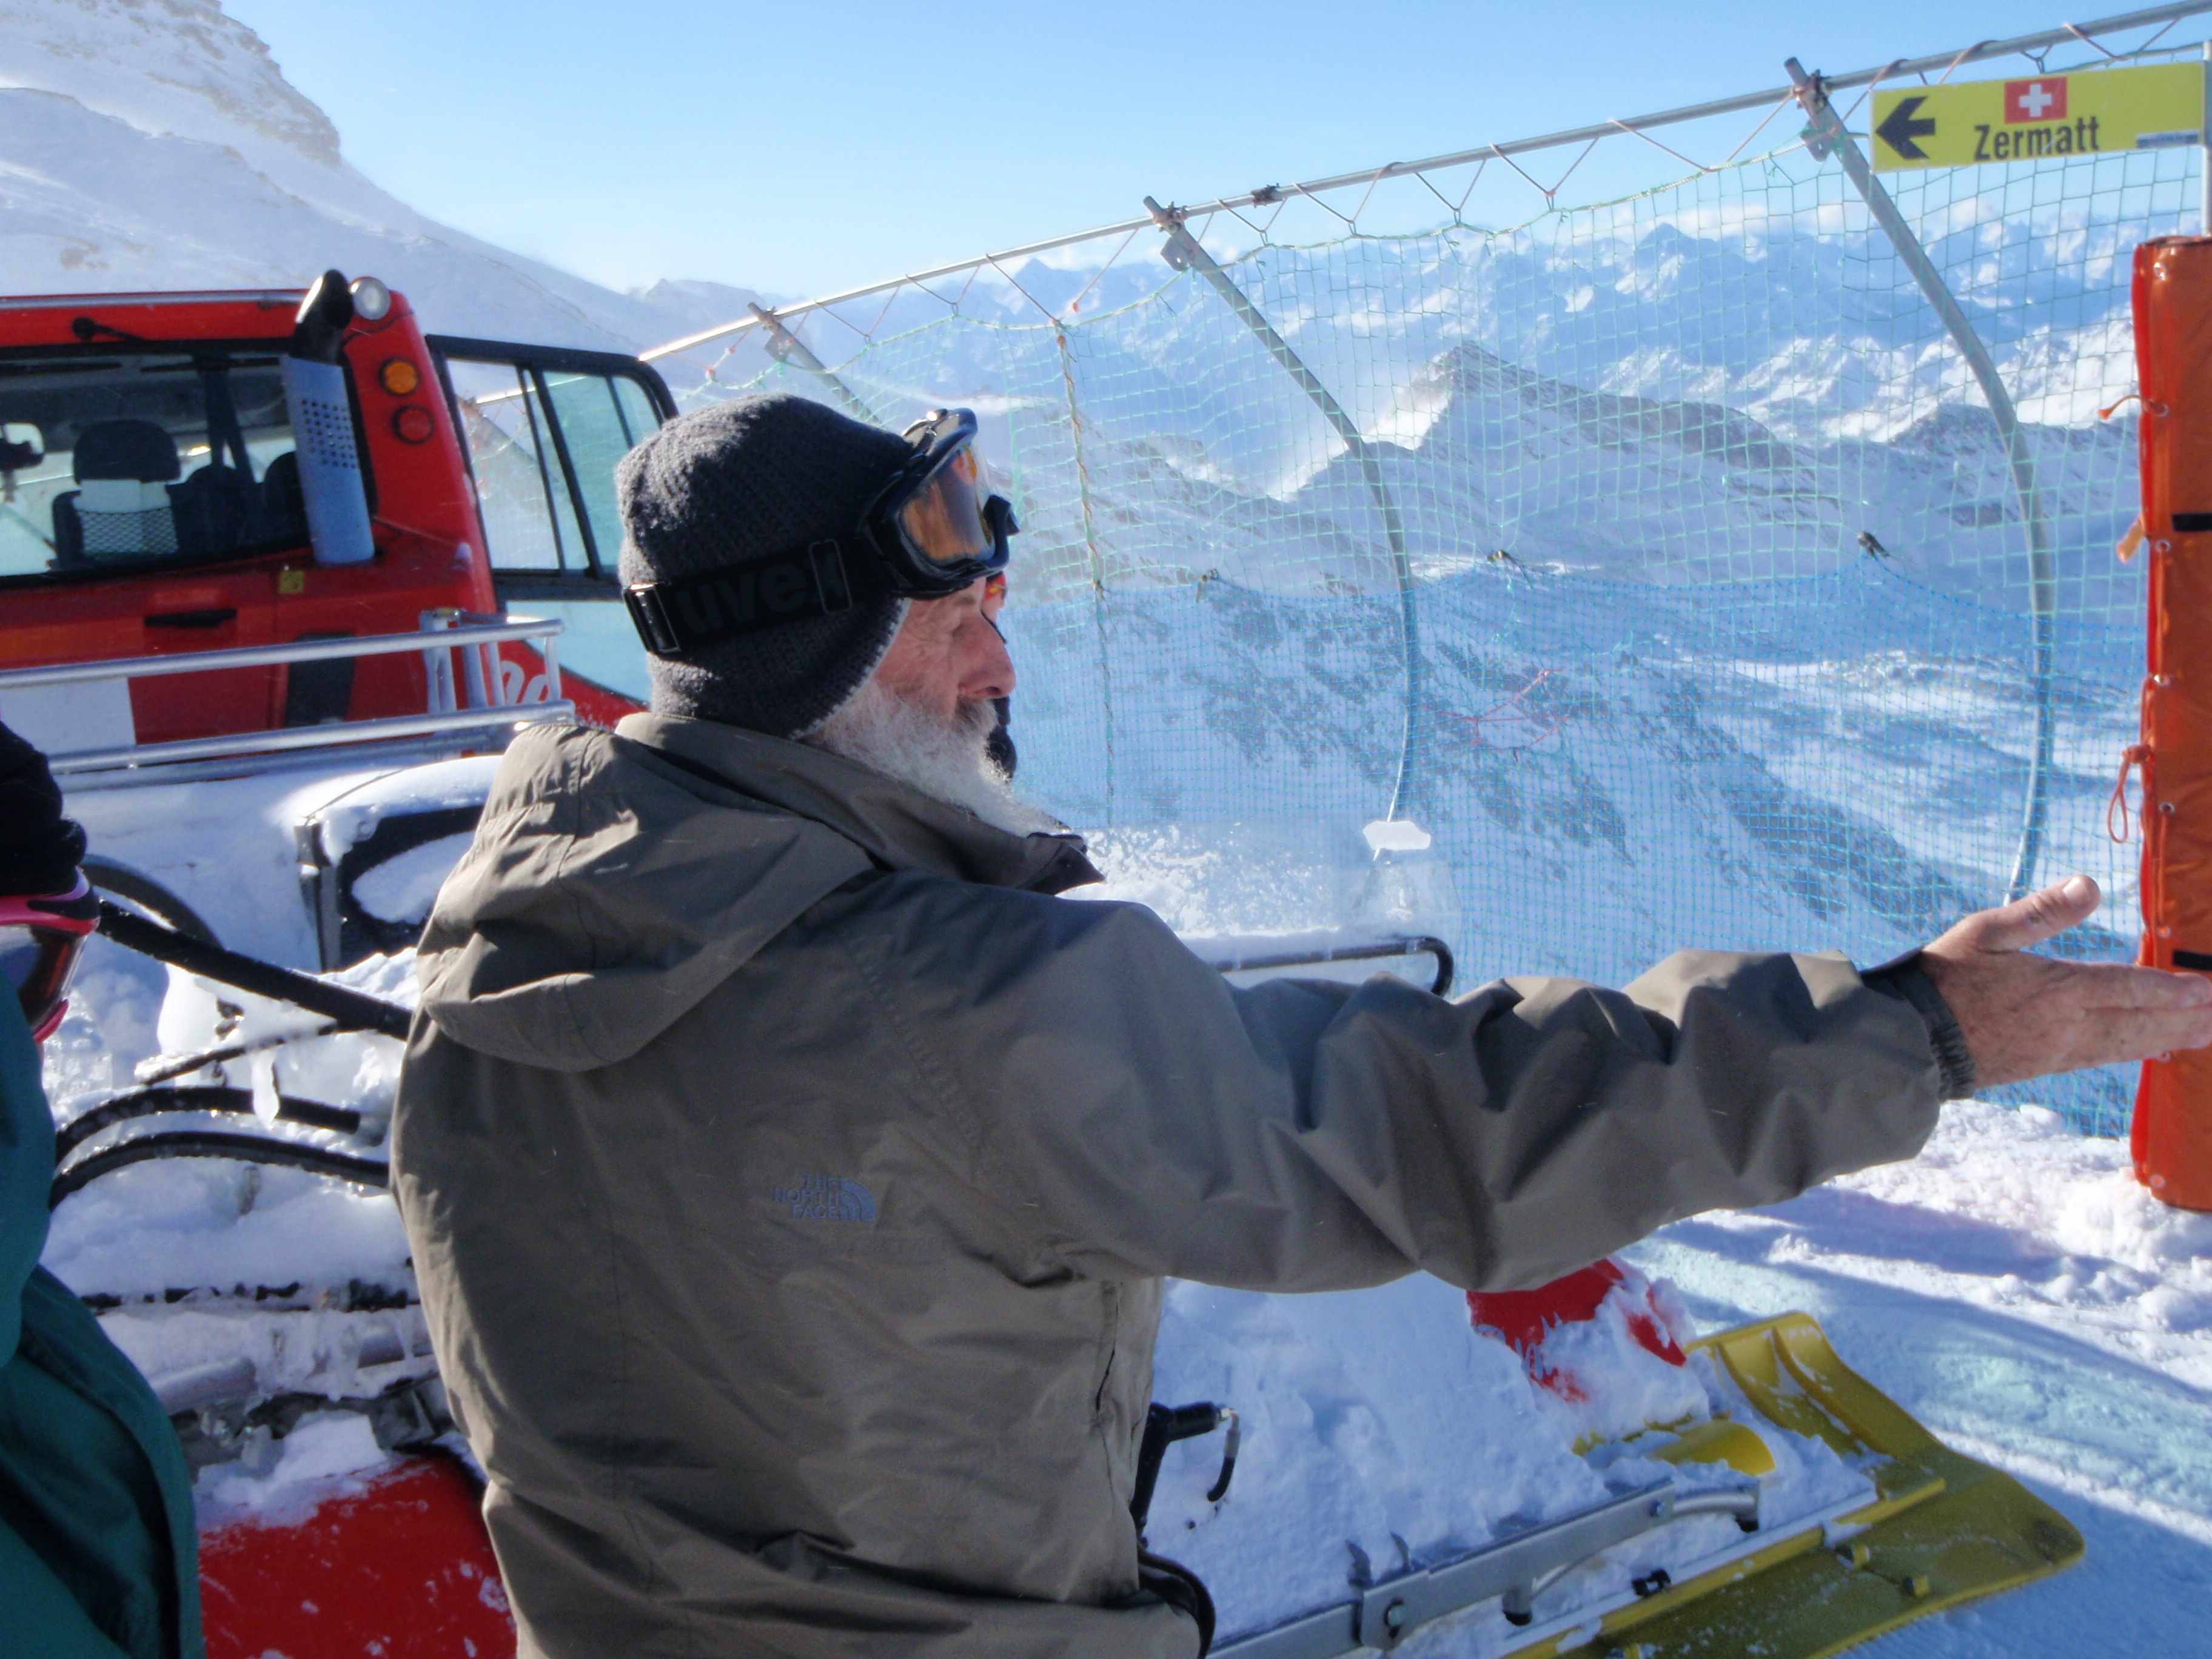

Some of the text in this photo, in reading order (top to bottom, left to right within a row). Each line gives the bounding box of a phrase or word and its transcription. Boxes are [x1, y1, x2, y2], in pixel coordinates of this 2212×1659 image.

[1974, 116, 2100, 161] Zermatt
[801, 1173, 837, 1190] THE
[774, 1186, 839, 1207] NORTH
[791, 1204, 838, 1220] FACE
